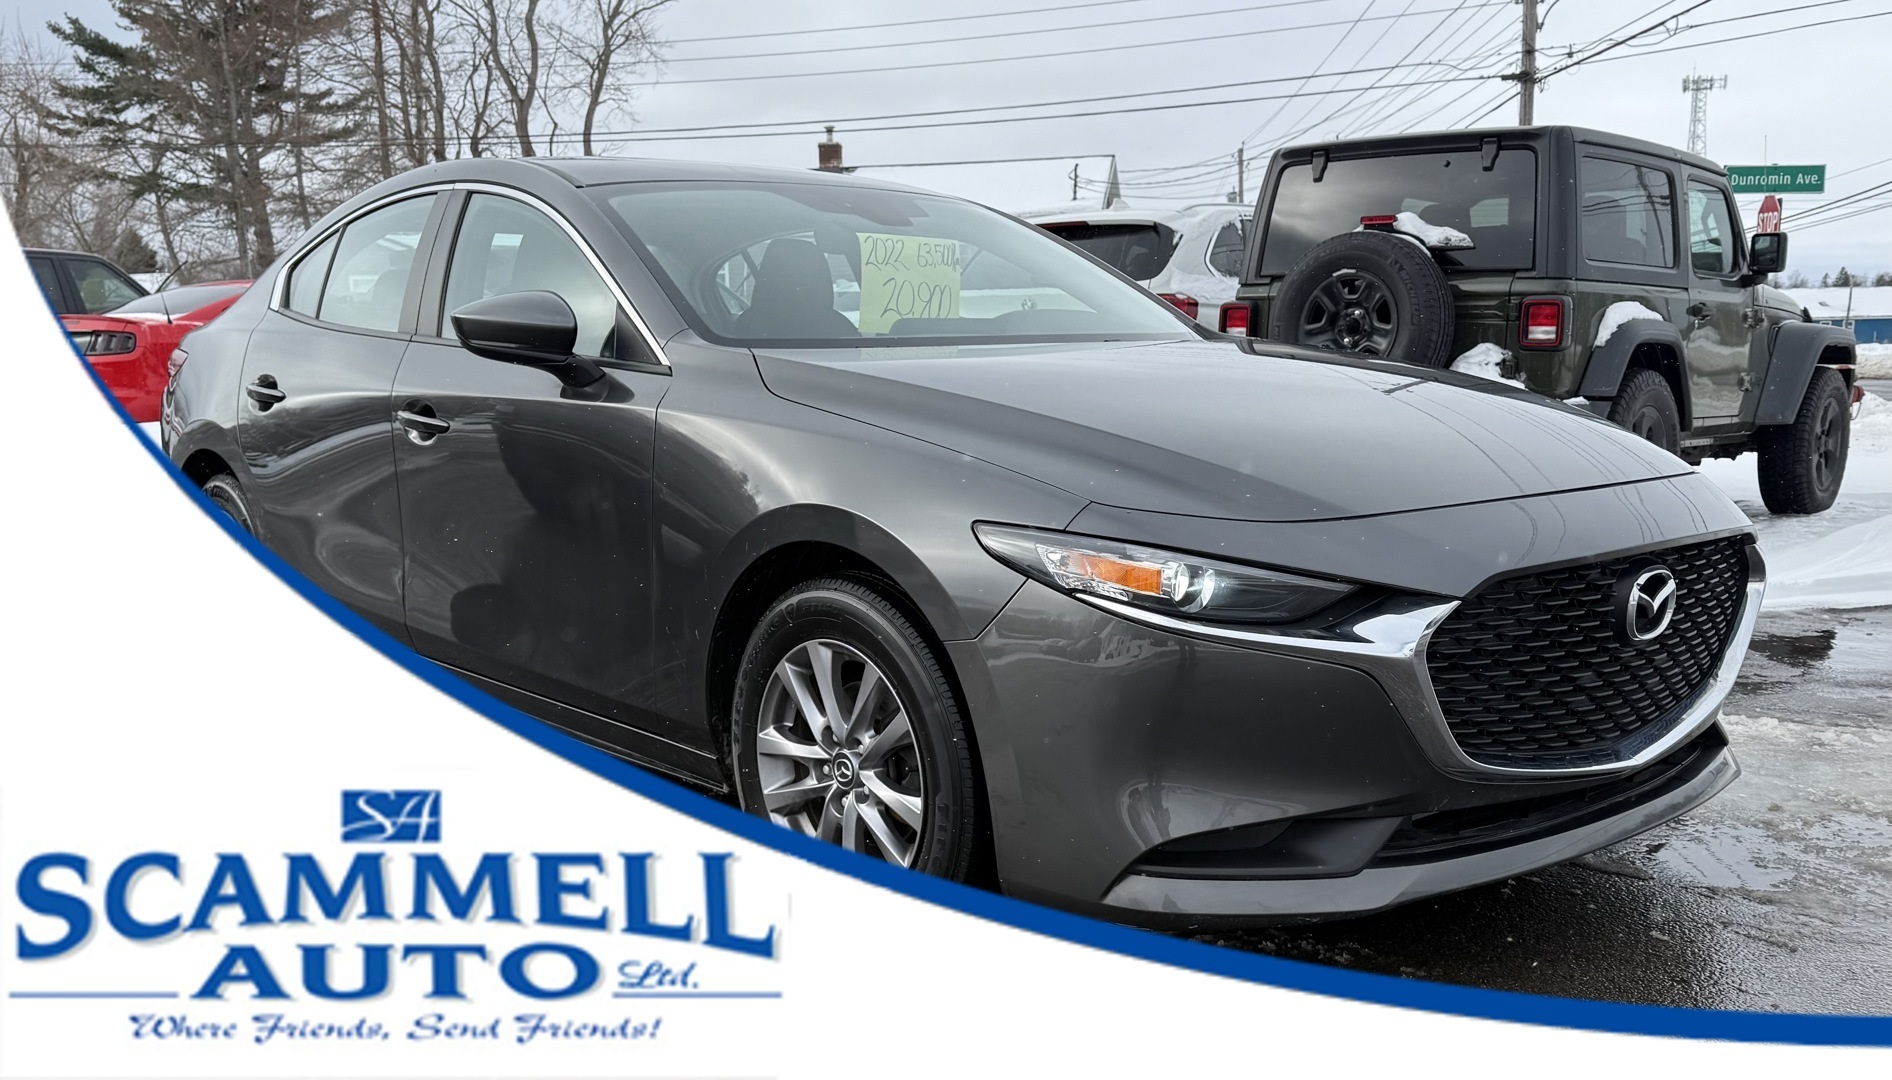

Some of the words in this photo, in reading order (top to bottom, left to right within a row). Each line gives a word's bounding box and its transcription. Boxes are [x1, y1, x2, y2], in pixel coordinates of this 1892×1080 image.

[1731, 173, 1791, 186] Dunromin
[1796, 172, 1821, 185] Ave.
[1758, 211, 1779, 233] STOP
[864, 235, 911, 272] 2022
